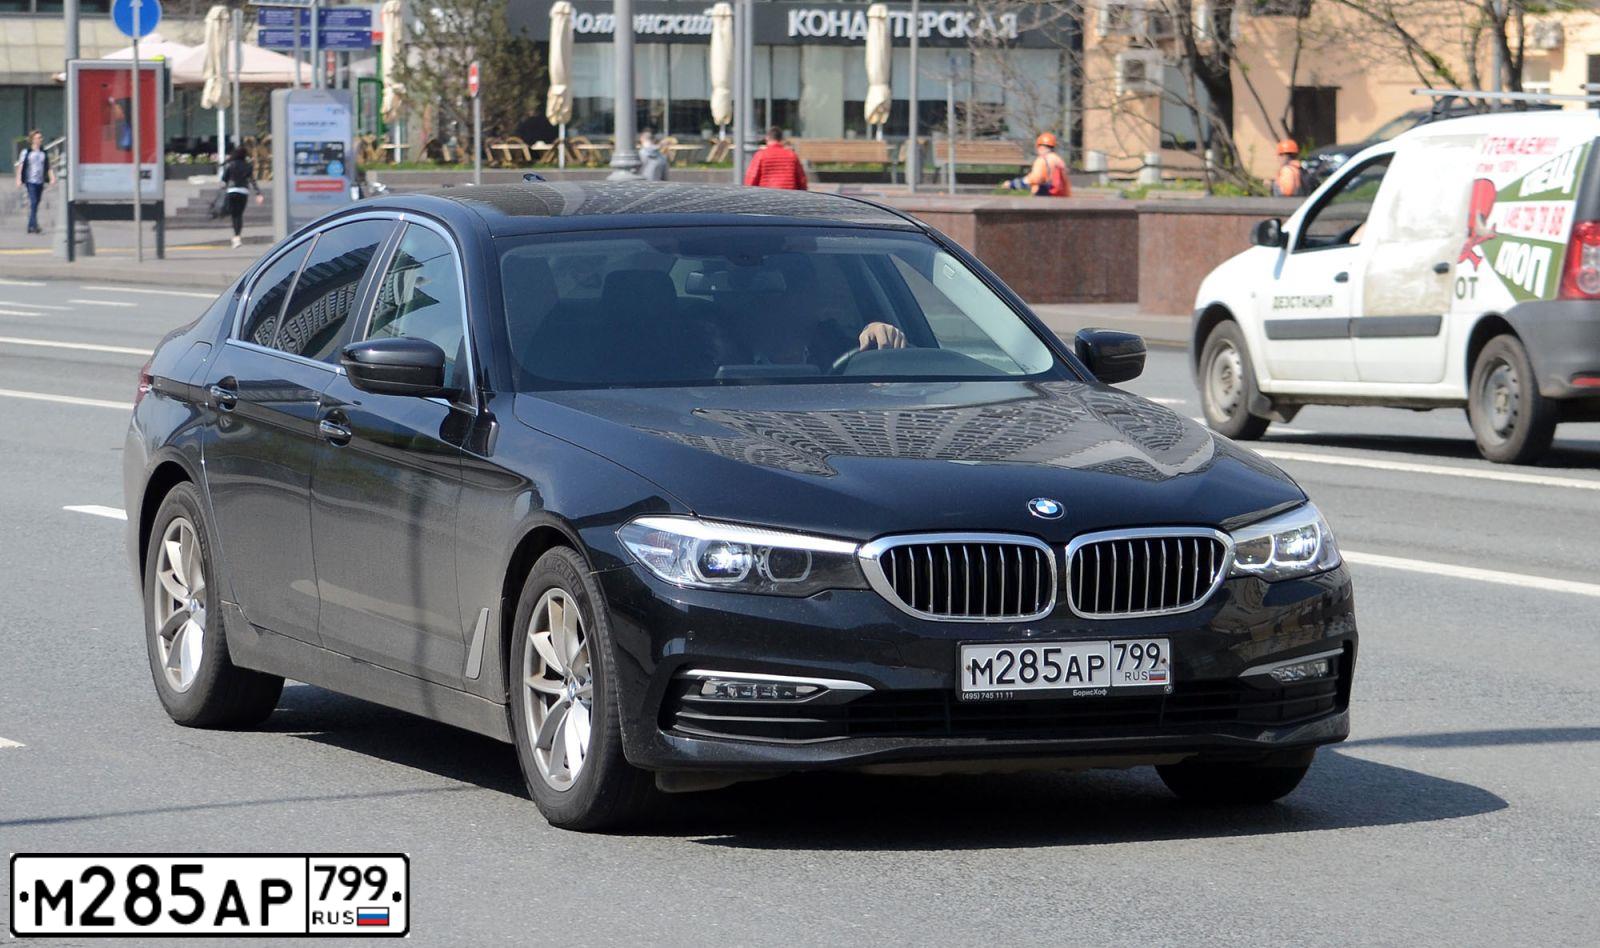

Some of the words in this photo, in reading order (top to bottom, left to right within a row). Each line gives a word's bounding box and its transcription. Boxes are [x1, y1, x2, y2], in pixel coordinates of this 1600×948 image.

[788, 10, 1018, 39] КОНДТЕРСКАЯ
[1113, 643, 1161, 670] 799
[1124, 671, 1148, 681] RUS
[962, 692, 980, 700] (495)
[1072, 688, 1108, 697] БорисХоф
